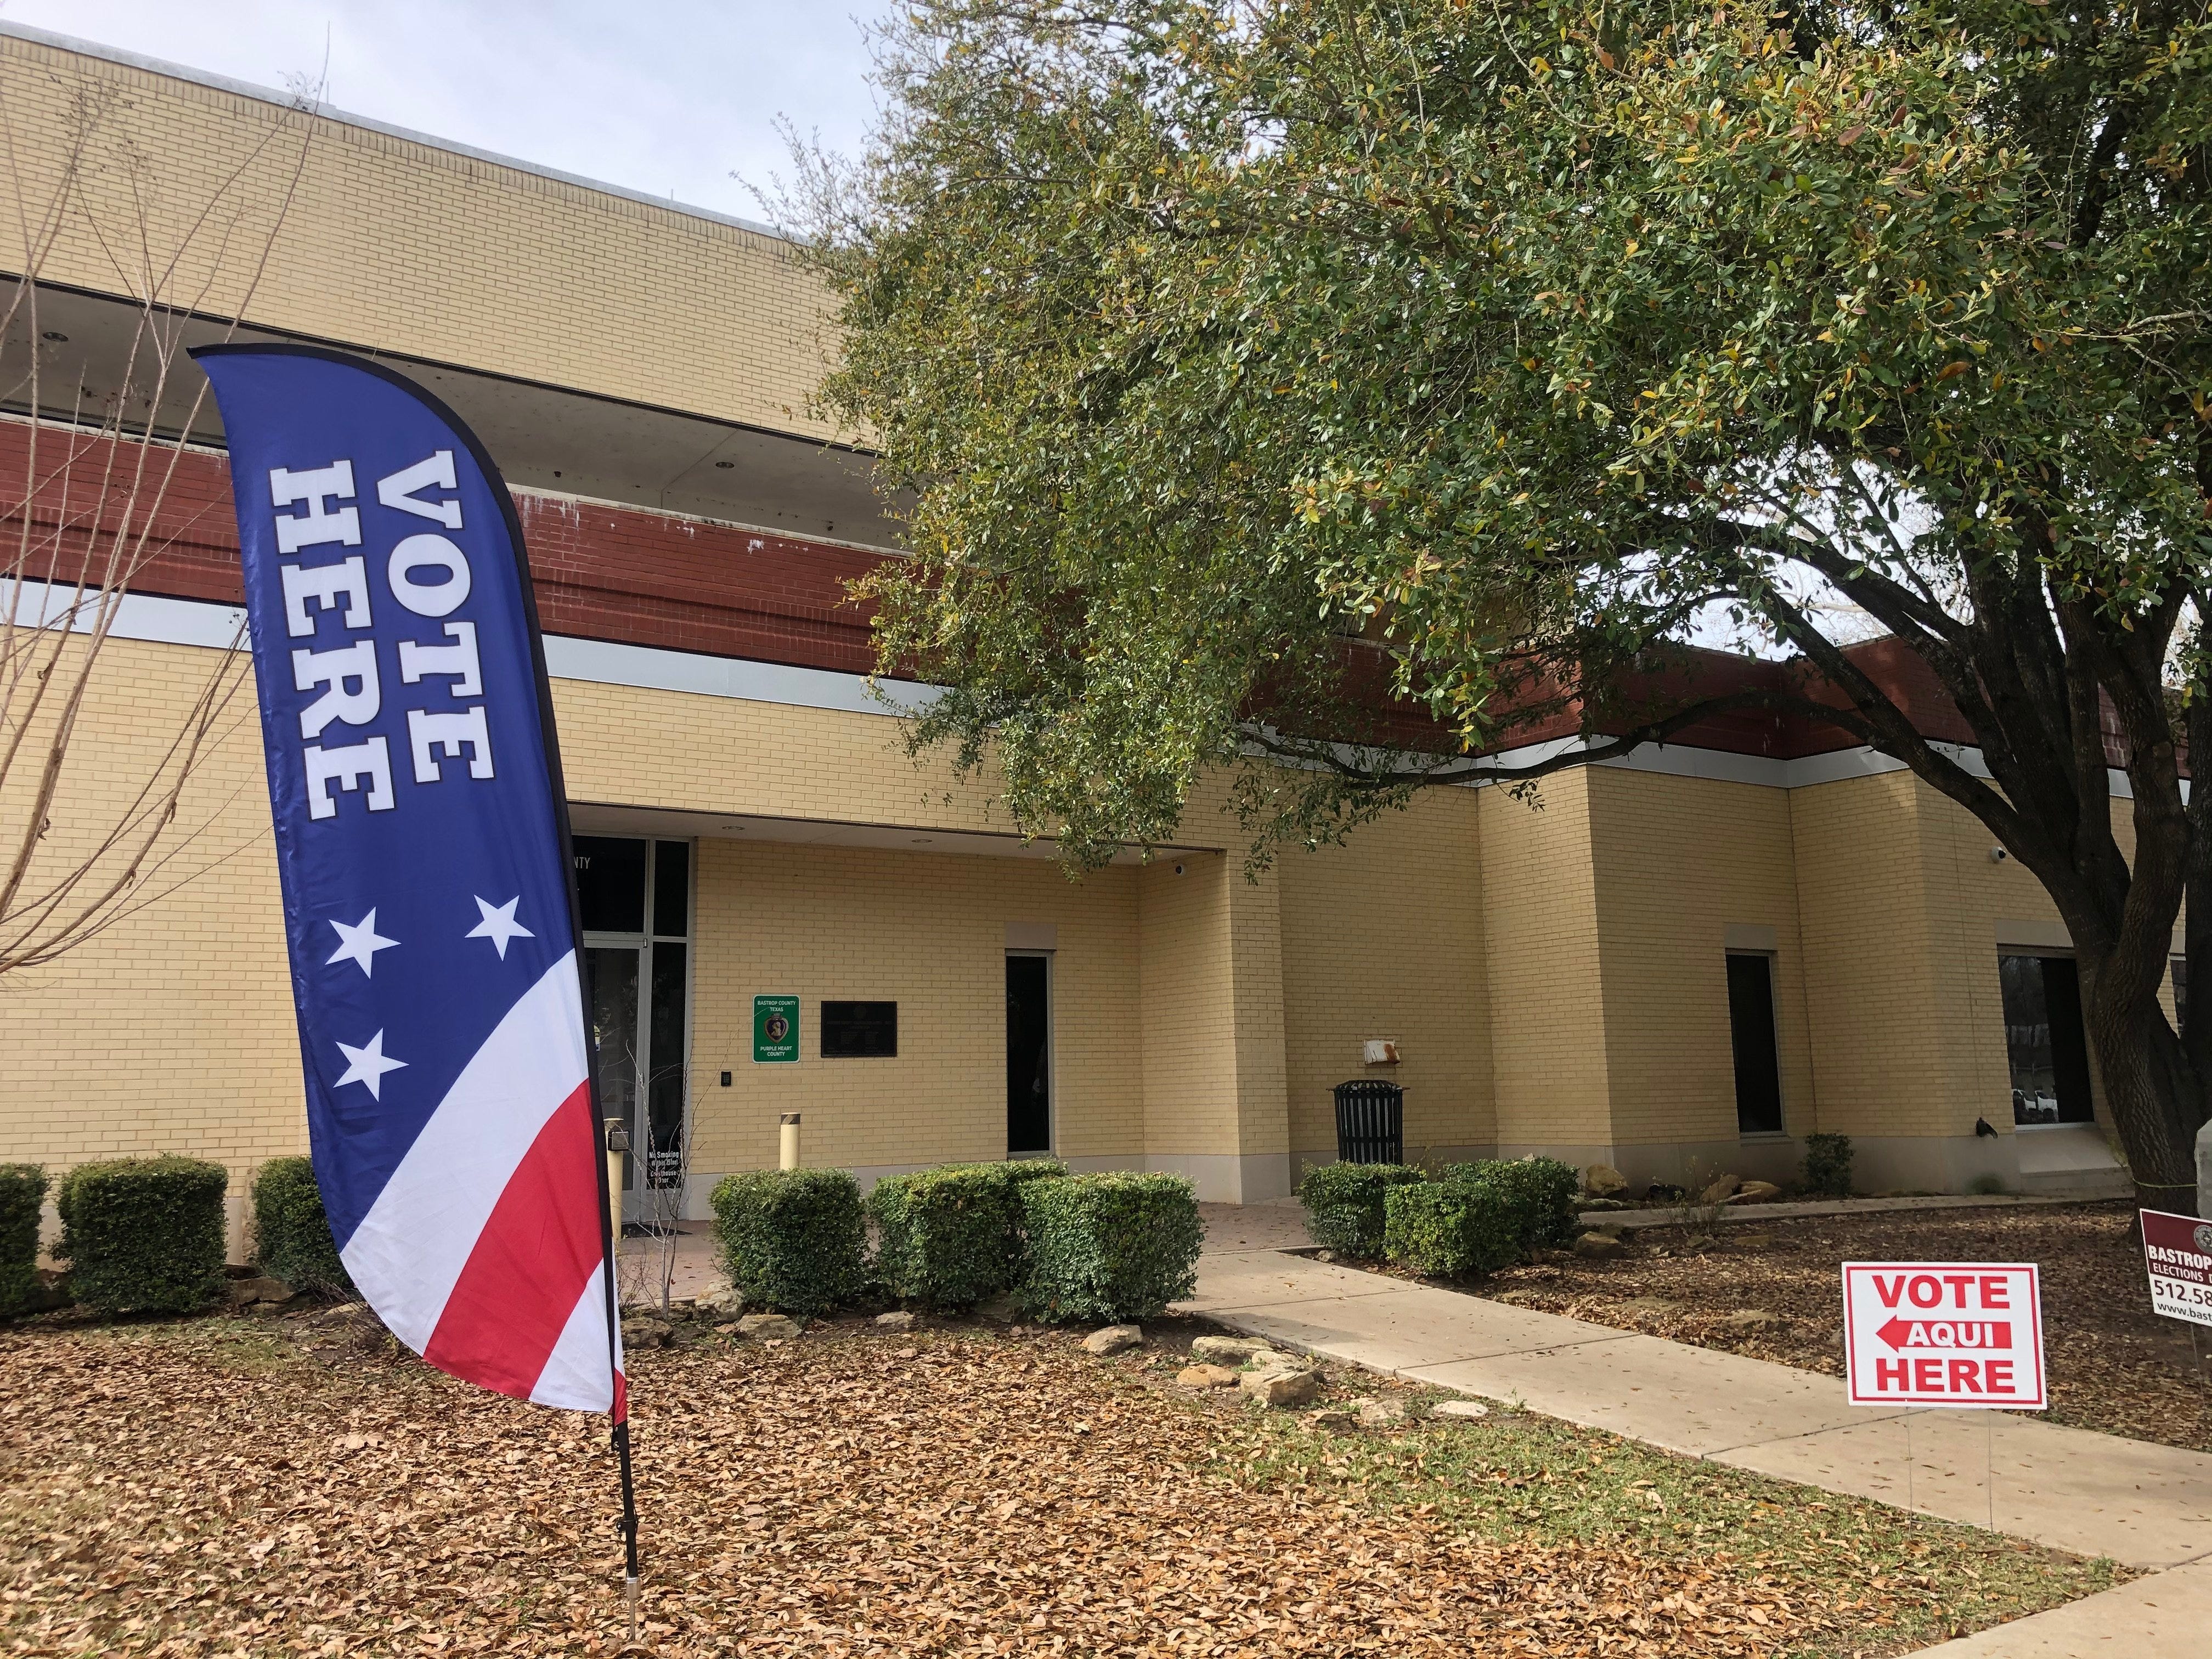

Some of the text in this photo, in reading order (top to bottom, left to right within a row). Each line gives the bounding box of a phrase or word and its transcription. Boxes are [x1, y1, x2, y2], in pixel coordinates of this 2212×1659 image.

[377, 450, 494, 783] VOTE
[269, 460, 395, 820] HERE
[2147, 1244, 2212, 1271] BASTROP
[2153, 1262, 2204, 1282] ELECTIONS
[1872, 1275, 2010, 1309] VOTE
[2154, 1279, 2212, 1307] 512.58
[1905, 1322, 1994, 1348] AQUI
[1875, 1358, 2016, 1394] HERE
